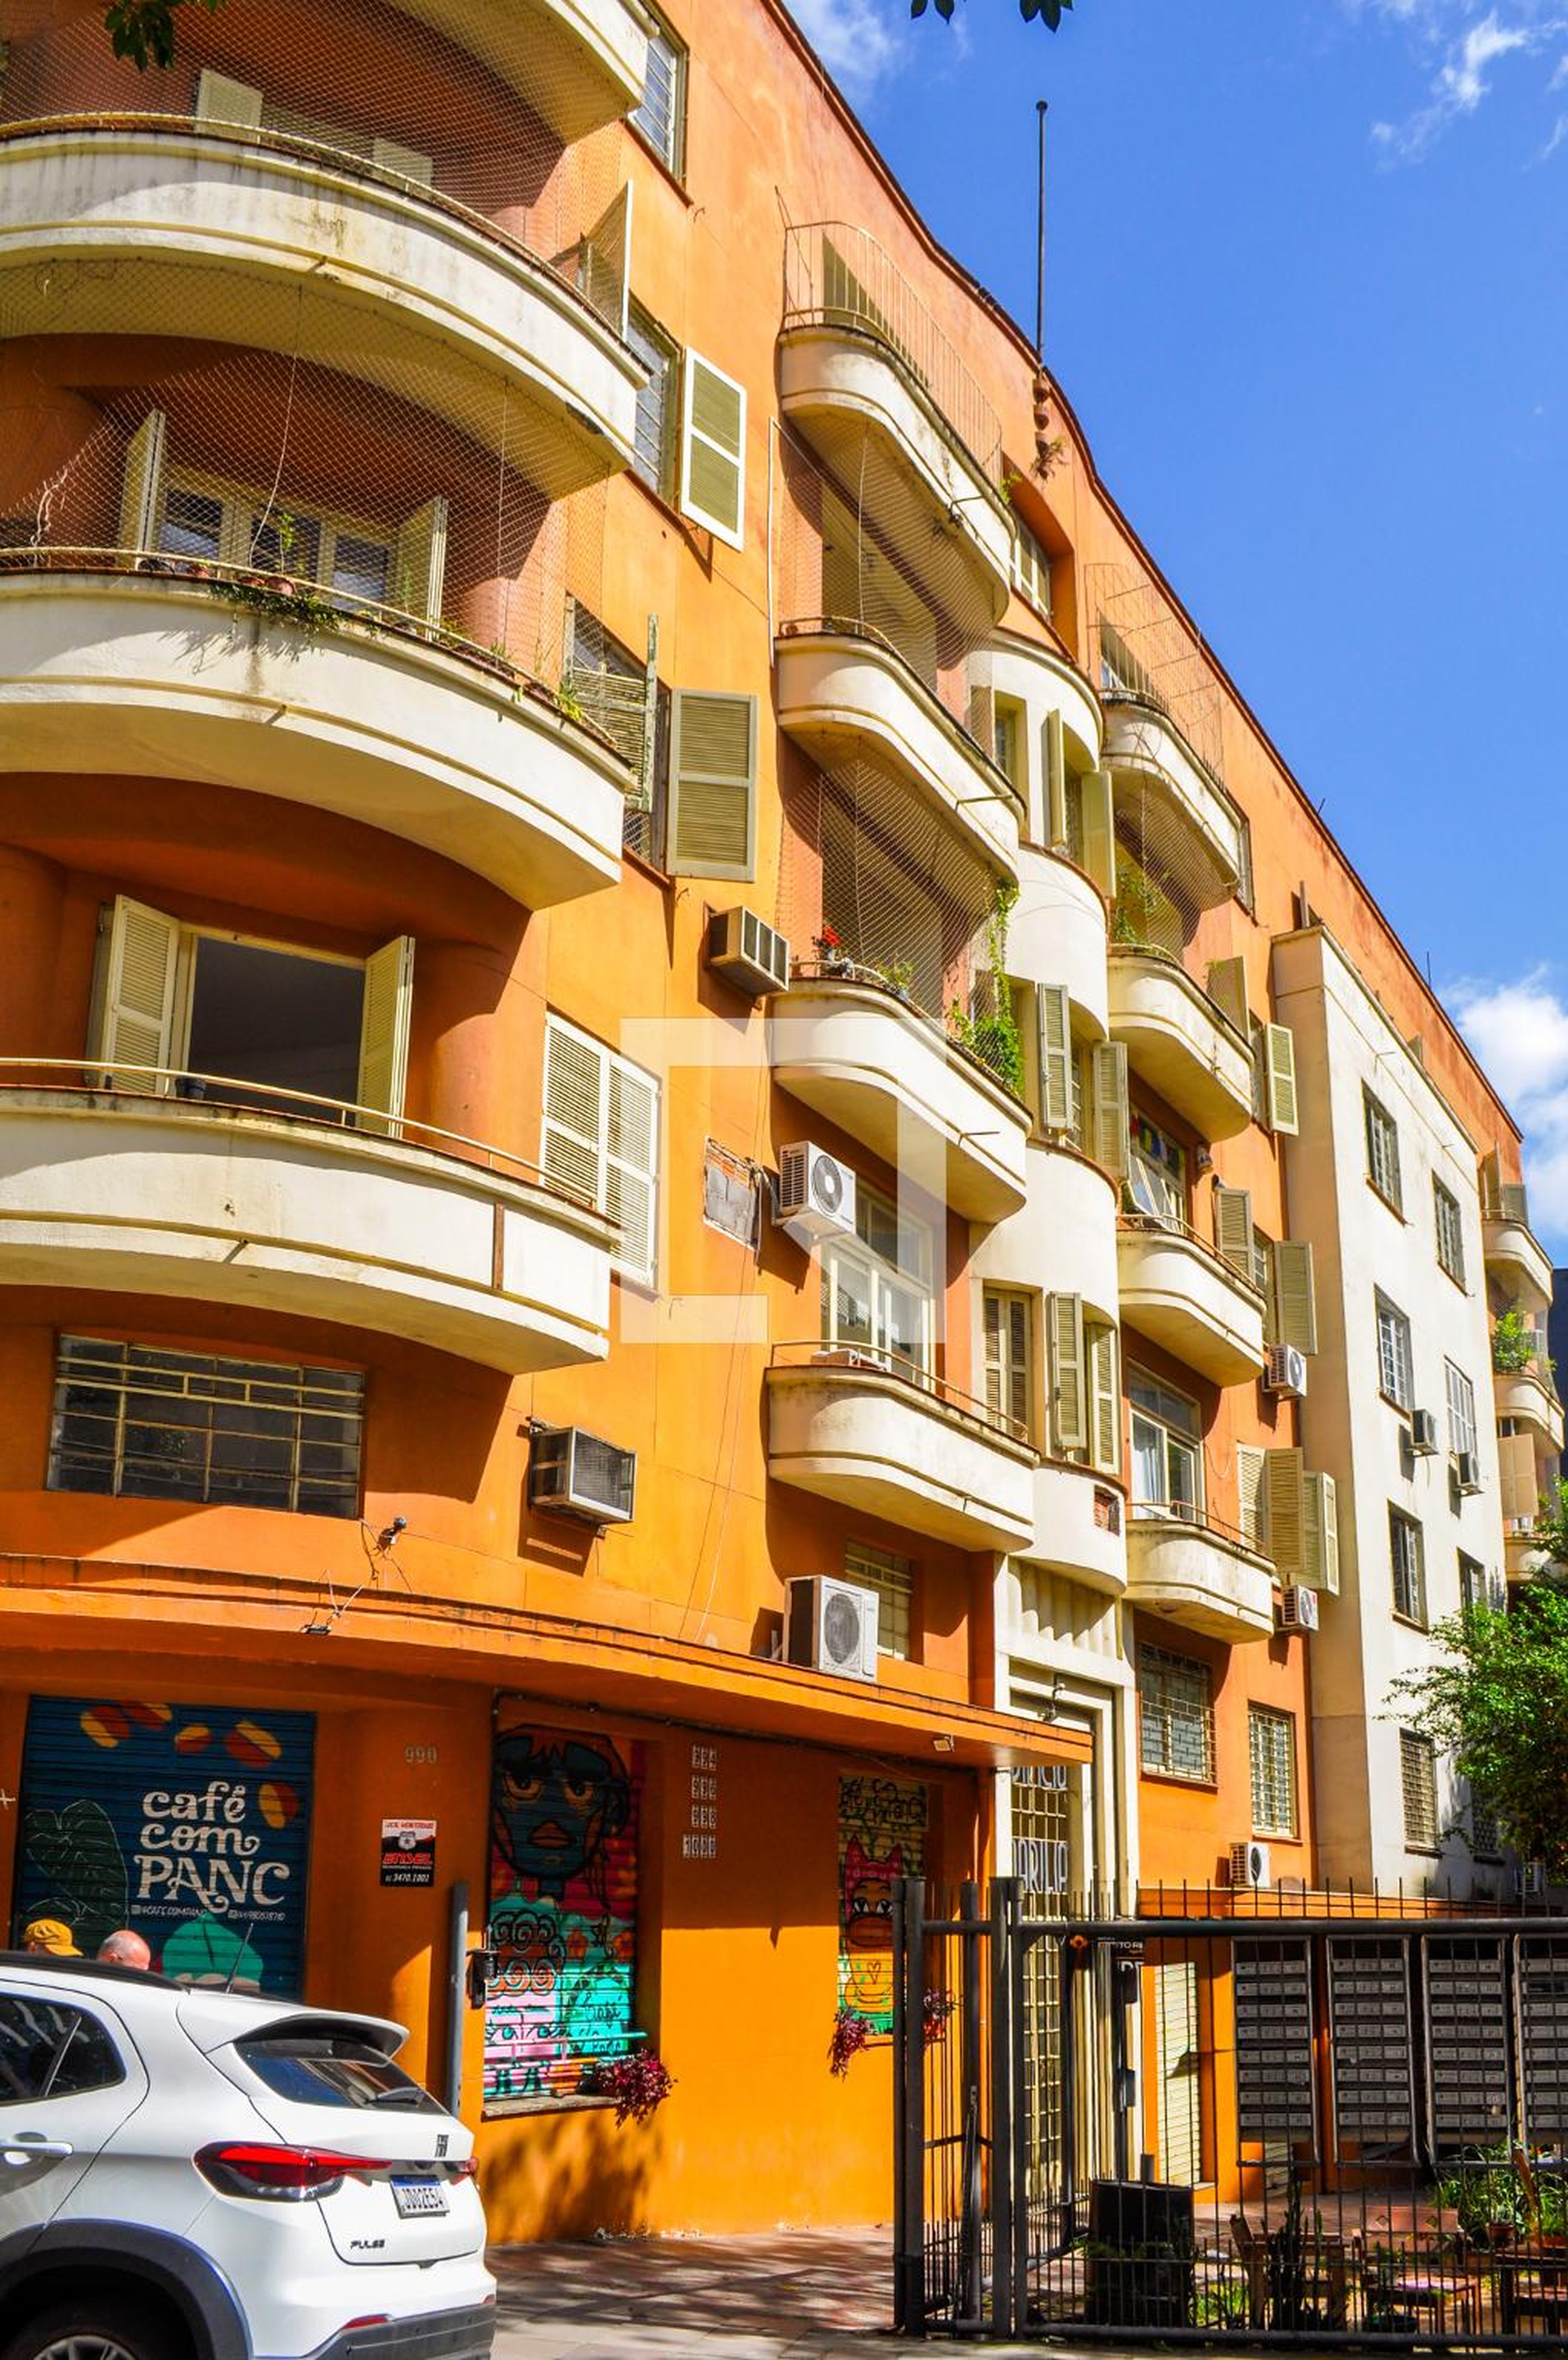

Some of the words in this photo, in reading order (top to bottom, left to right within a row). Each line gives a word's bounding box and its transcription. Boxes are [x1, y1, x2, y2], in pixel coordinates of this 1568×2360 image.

[405, 1746, 437, 1763] 990
[143, 1781, 246, 1823] café
[134, 1854, 290, 1914] PANC
[1013, 1839, 1068, 1894] ARILIA
[350, 2239, 385, 2249] PULSE
